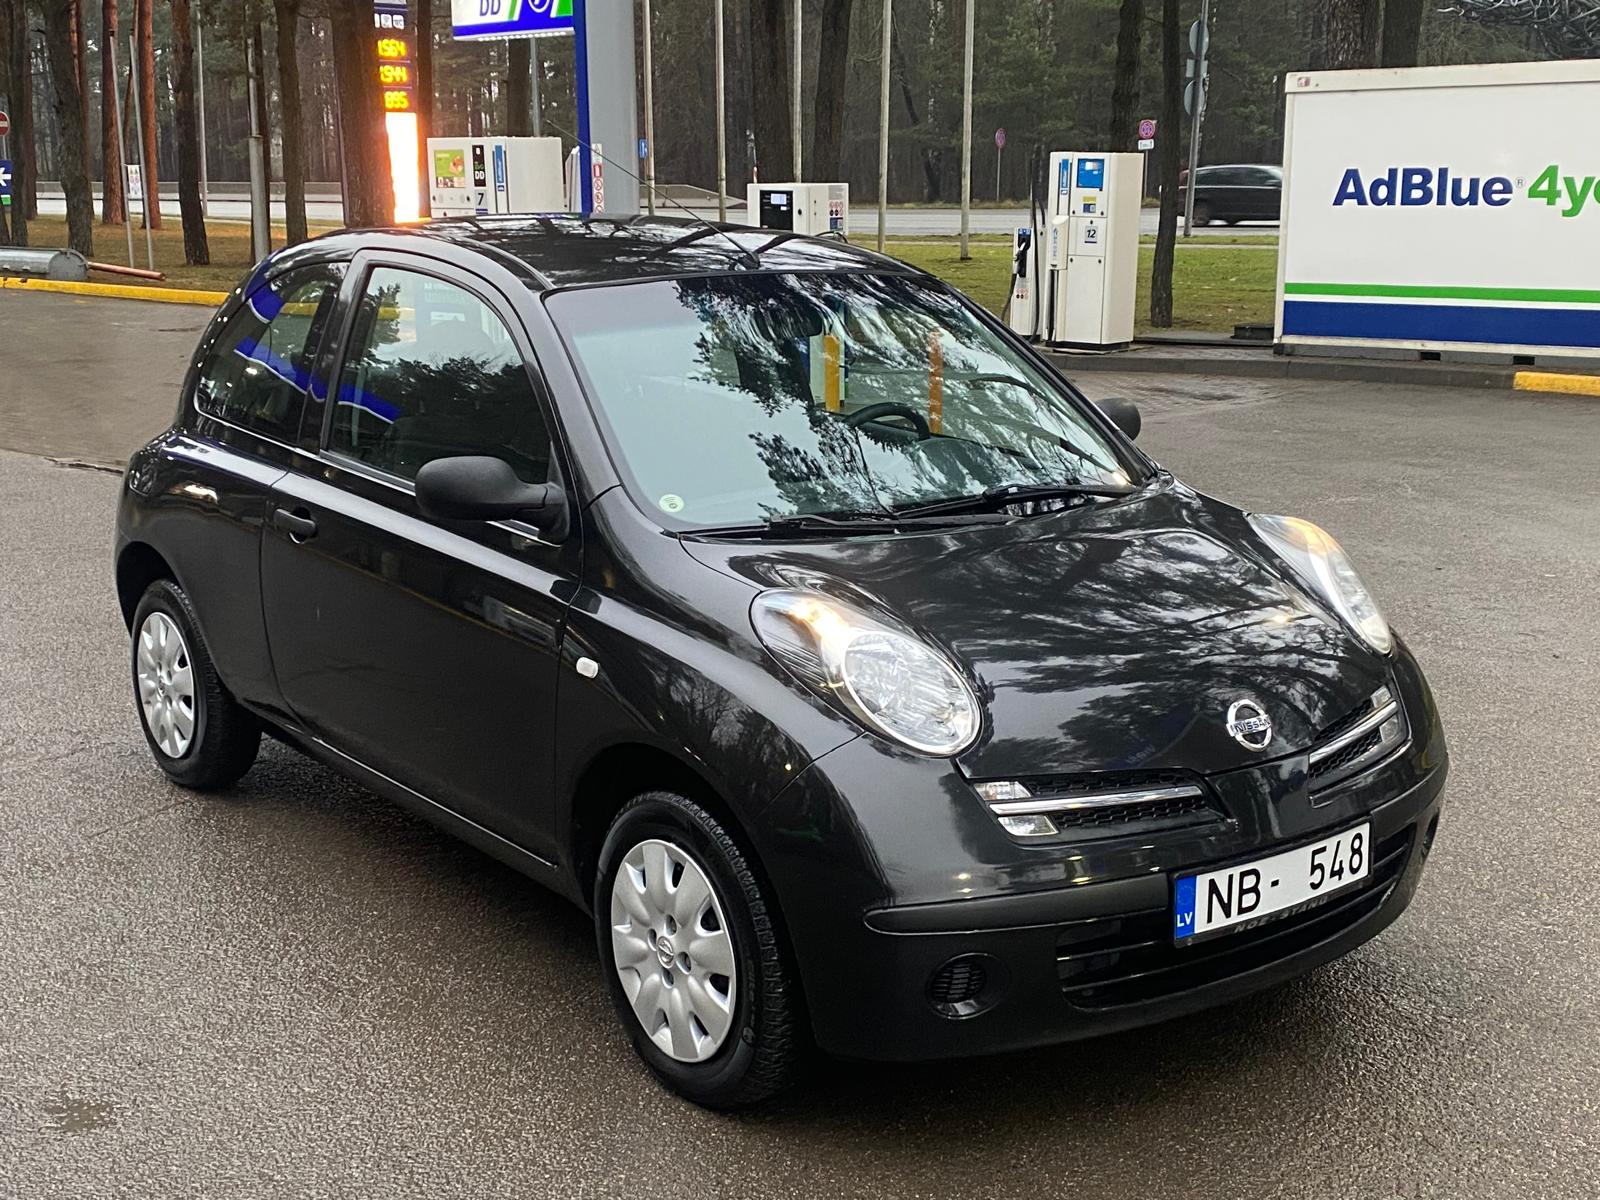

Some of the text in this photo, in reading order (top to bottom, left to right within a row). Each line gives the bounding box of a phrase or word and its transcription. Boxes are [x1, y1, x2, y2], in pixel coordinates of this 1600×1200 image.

[478, 193, 484, 206] 7
[1086, 229, 1097, 238] 12
[1234, 716, 1271, 733] NISSAN
[1176, 911, 1193, 928] LV
